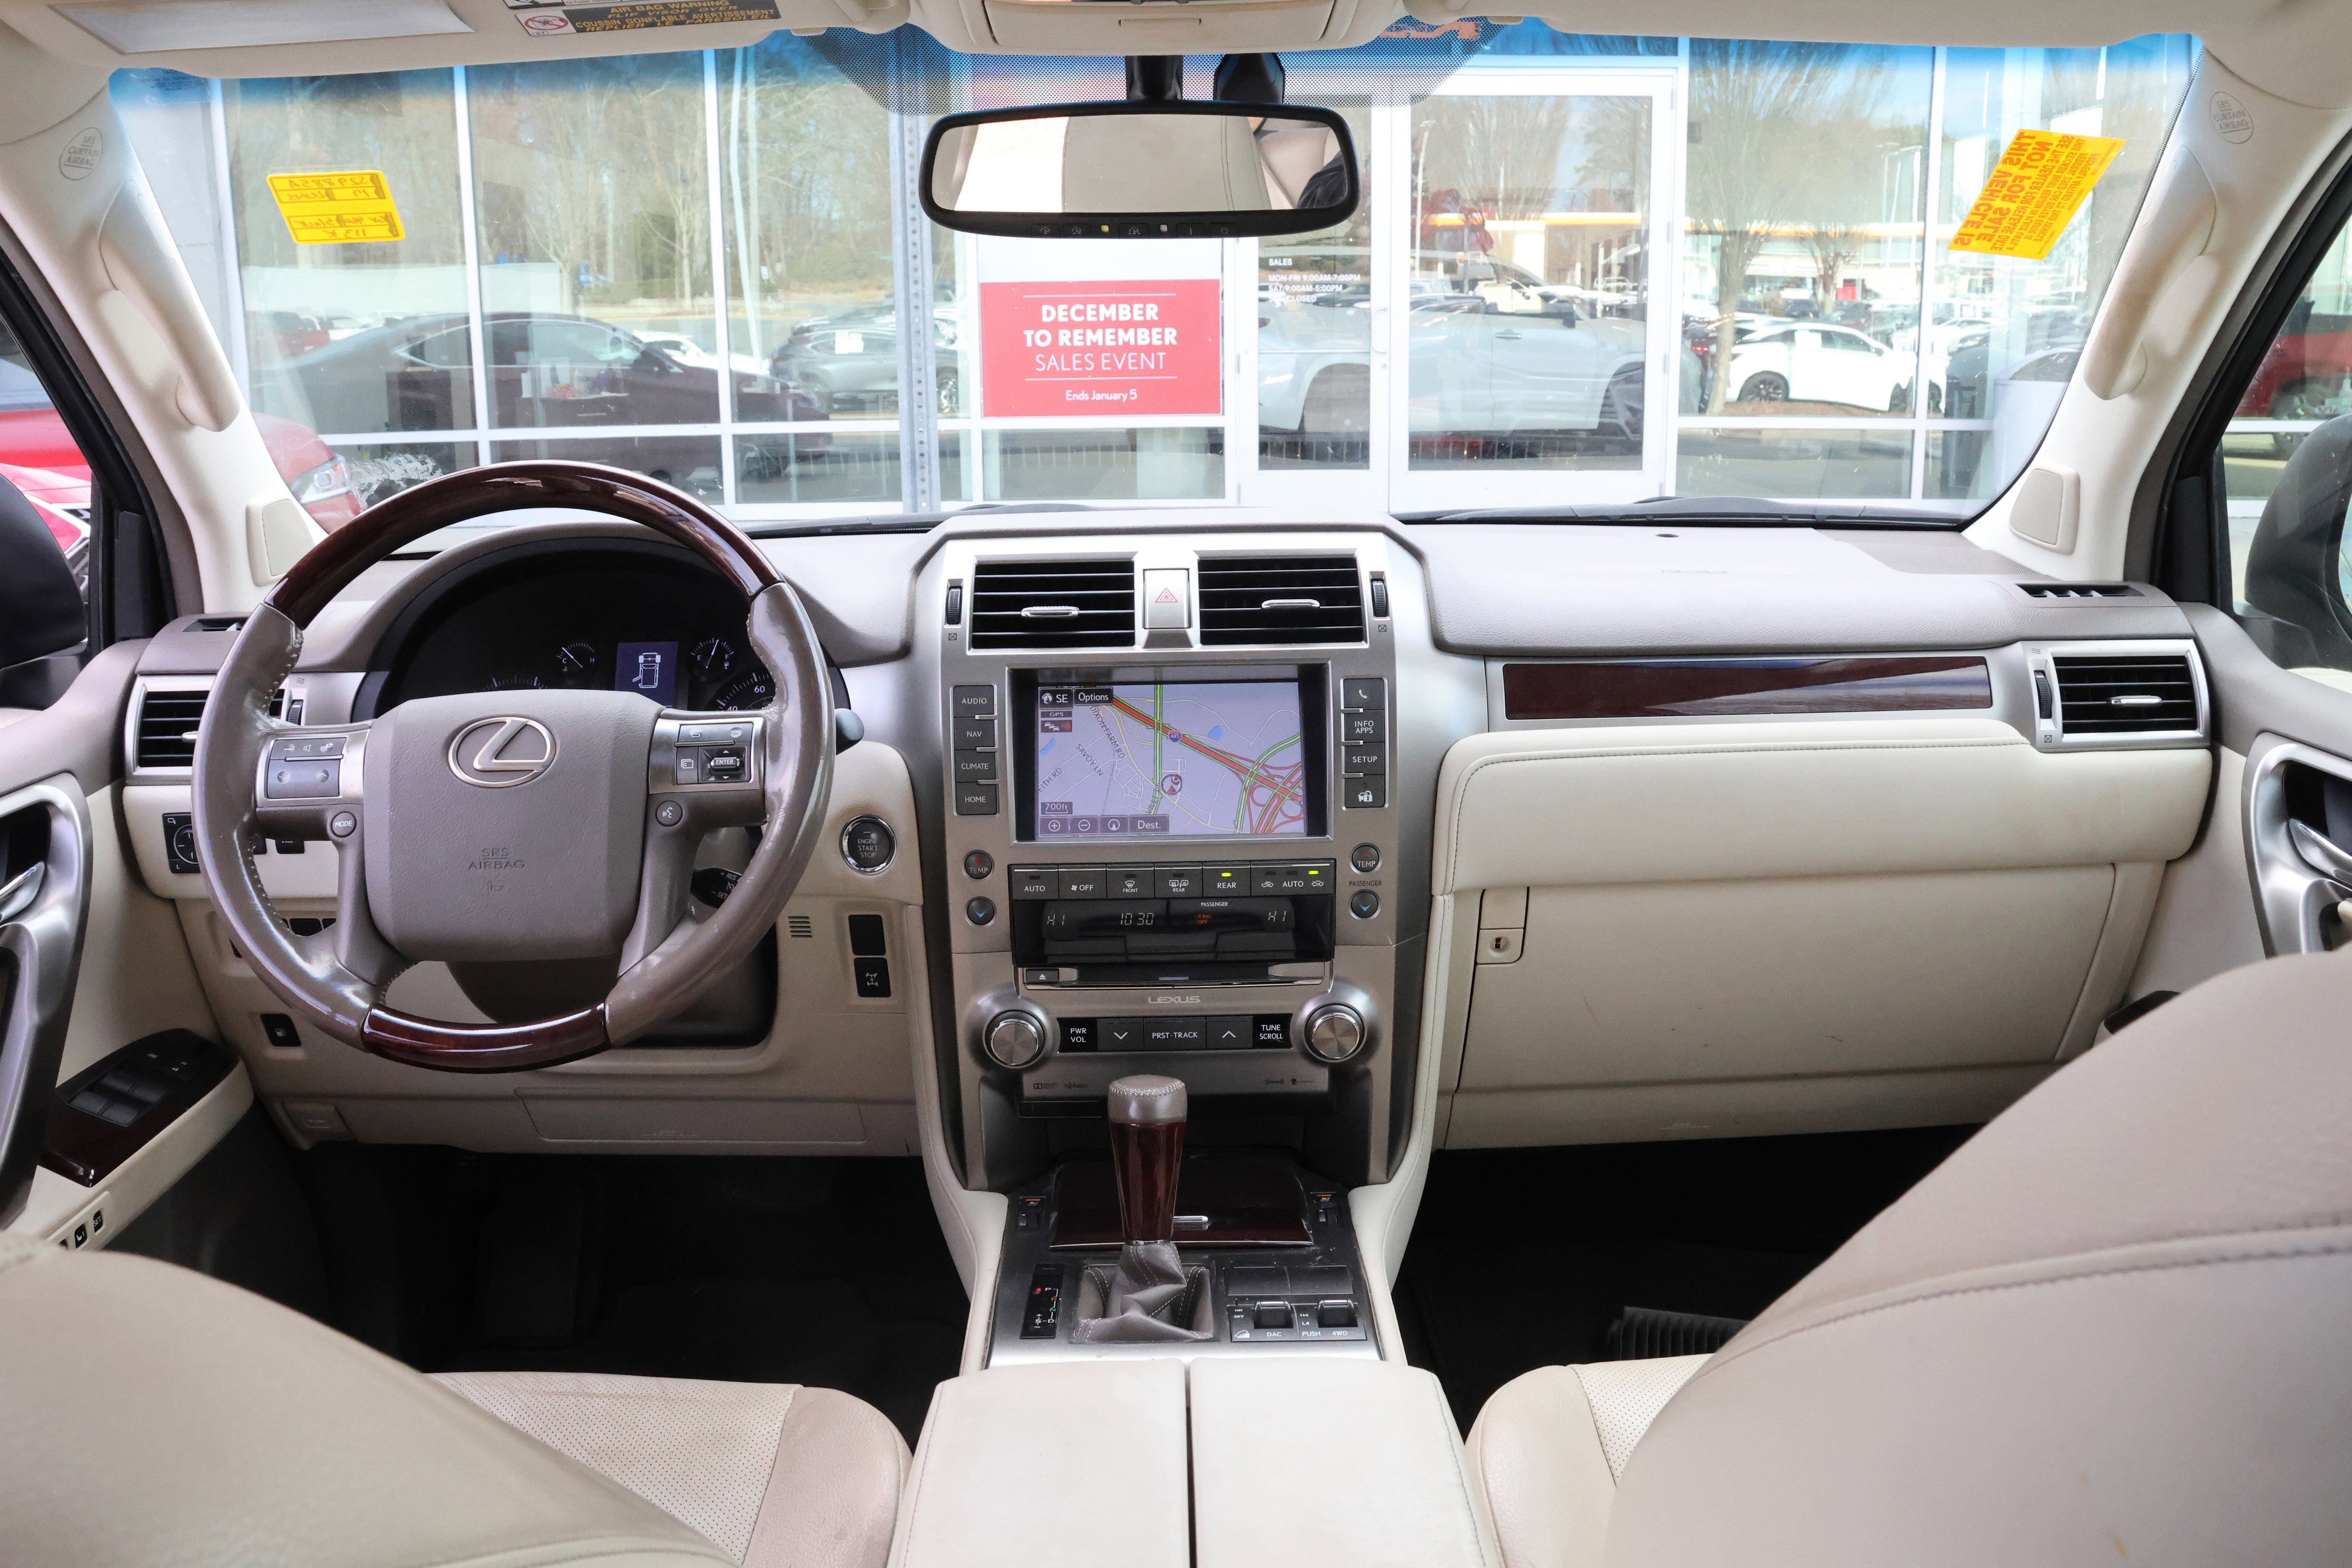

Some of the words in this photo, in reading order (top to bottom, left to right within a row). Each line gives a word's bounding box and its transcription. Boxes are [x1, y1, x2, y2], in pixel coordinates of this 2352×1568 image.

[668, 0, 730, 9] WARNING
[575, 20, 621, 28] COUSSIN
[627, 15, 686, 24] GONFLABLE
[693, 9, 774, 20] AVERTISSEMENT
[2214, 110, 2245, 122] CURTAIN
[2219, 119, 2248, 130] AIRBAG
[68, 146, 99, 156] CURTAIN
[65, 156, 95, 166] AIRBAG
[1269, 258, 1293, 266] SALES
[1042, 303, 1158, 322] DECEMBER
[1023, 329, 1052, 347] TO
[1058, 327, 1178, 347] REMEMBER
[1036, 353, 1095, 372] SALES
[1102, 352, 1167, 370] EVENT
[1065, 390, 1090, 401] Ends
[1091, 389, 1128, 402] January
[1129, 389, 1138, 400] 5
[1056, 694, 1068, 703] SE
[1078, 693, 1109, 702] Options
[1089, 705, 1107, 728] DIXON
[1103, 728, 1119, 748] FARM
[1115, 748, 1125, 759] RD
[1075, 743, 1097, 766] SAVOY
[1094, 764, 1104, 777] LN
[1052, 768, 1062, 778] RD
[1138, 820, 1161, 830] Dest.
[482, 848, 509, 857] SRS
[469, 860, 525, 870] AIRBAG
[726, 873, 737, 881] RES
[1148, 996, 1201, 1004] LEXUS
